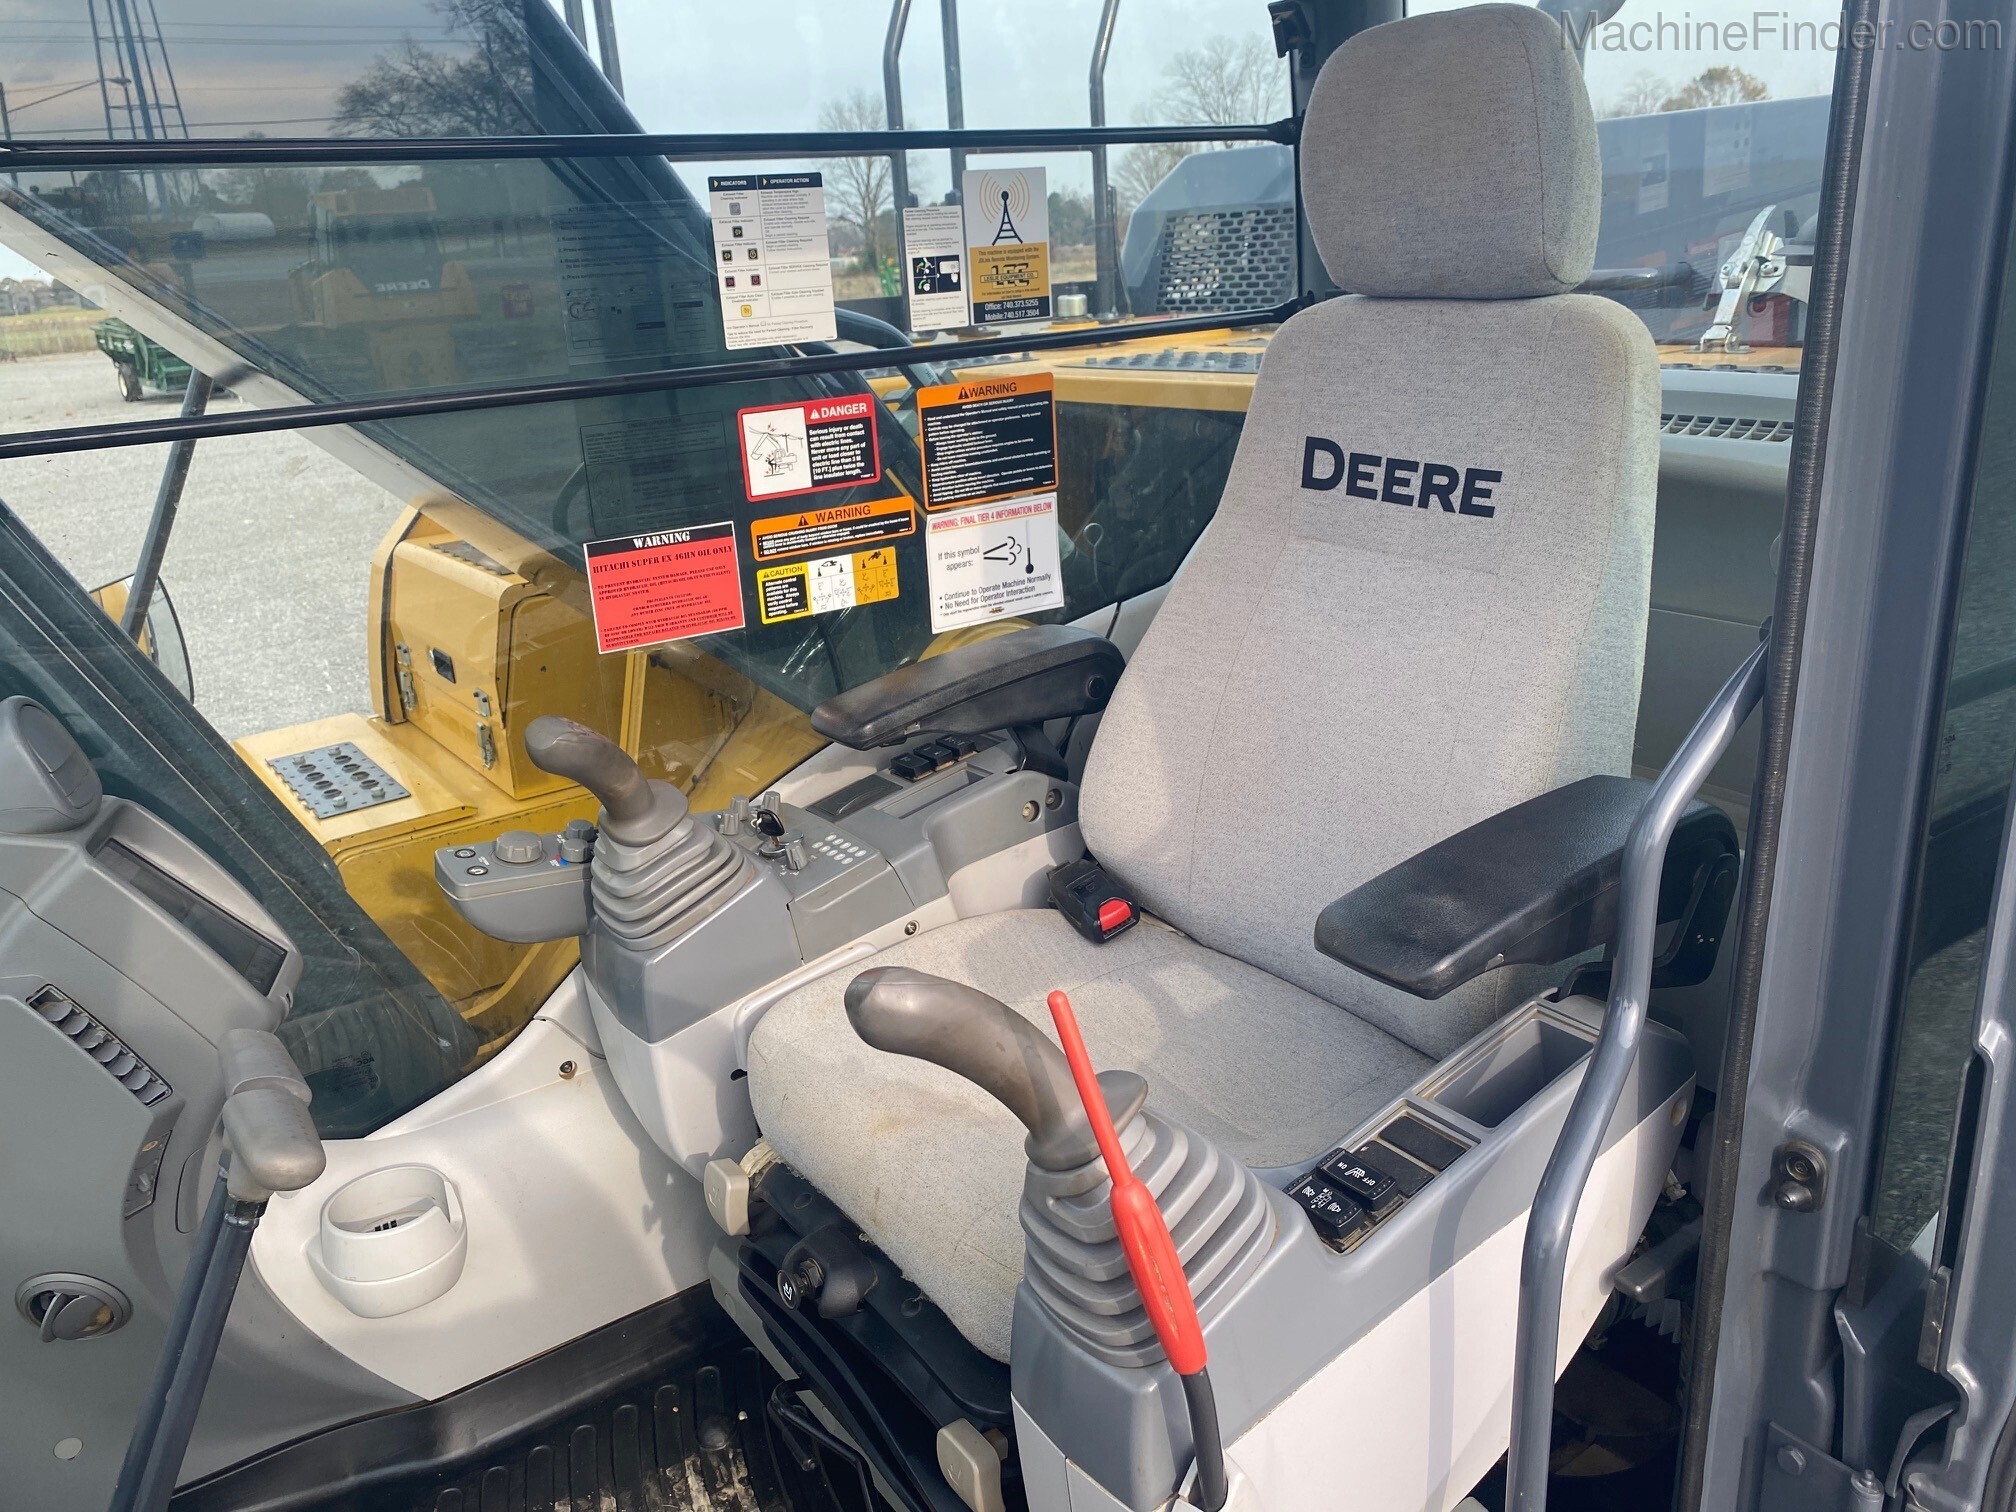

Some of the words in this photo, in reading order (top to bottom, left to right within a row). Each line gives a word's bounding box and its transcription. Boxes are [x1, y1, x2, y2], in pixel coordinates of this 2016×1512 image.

[985, 302, 1002, 310] Office:
[1003, 298, 1038, 309] 740.373.5255
[969, 382, 1017, 398] WARNING
[821, 402, 867, 418] DANGER
[1301, 436, 1502, 518] DEERE
[816, 505, 871, 523] WARNING
[932, 518, 959, 531] WARNING:
[961, 516, 975, 526] FINAL
[978, 513, 990, 522] TIER
[996, 505, 1032, 519] INFORMATION
[1033, 502, 1052, 512] BELOW
[633, 531, 690, 549] WARNING
[593, 561, 630, 574] HITACHI
[631, 556, 659, 568] SUPER
[661, 554, 672, 563] EX
[697, 548, 712, 557] OIL
[712, 545, 733, 555] ONLY
[944, 550, 956, 559] this
[957, 546, 980, 559] symbol
[770, 566, 803, 577] CAUTION
[946, 560, 973, 571] appears:
[945, 590, 970, 601] Continue
[979, 583, 1000, 595] Operate
[1002, 578, 1025, 589] Machine
[1027, 572, 1051, 585] Normally
[955, 599, 969, 608] Need
[980, 591, 1005, 604] Operator
[1006, 585, 1035, 597] Interaction
[1336, 1160, 1347, 1170] ON
[1363, 1176, 1376, 1187] OFF
